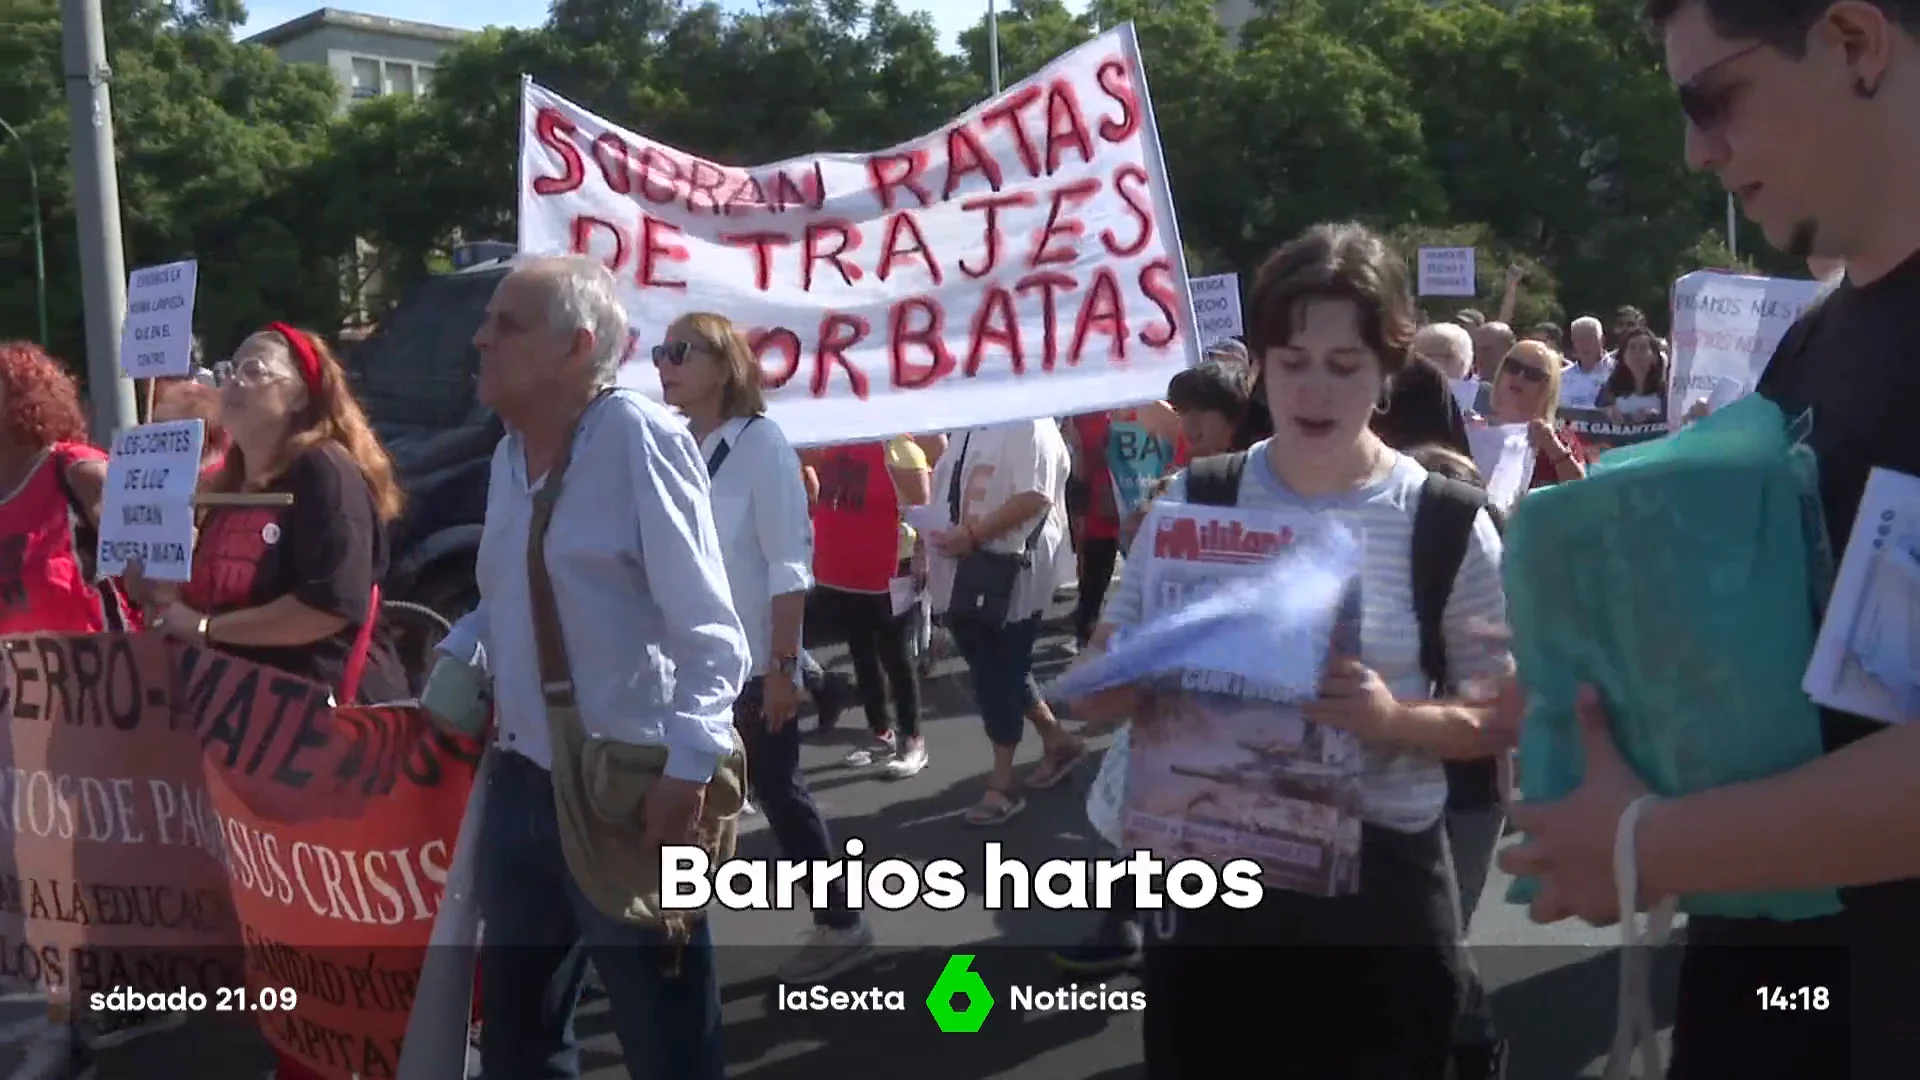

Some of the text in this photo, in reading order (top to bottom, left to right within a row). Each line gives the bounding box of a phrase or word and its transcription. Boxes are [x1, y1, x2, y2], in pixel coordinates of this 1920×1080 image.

[534, 59, 1141, 216] SOBRAN RATAS
[569, 165, 1154, 293] DE TRAJES
[748, 260, 1178, 400] ORBATAS
[124, 467, 170, 490] DE LUZ
[79, 776, 144, 843] DE
